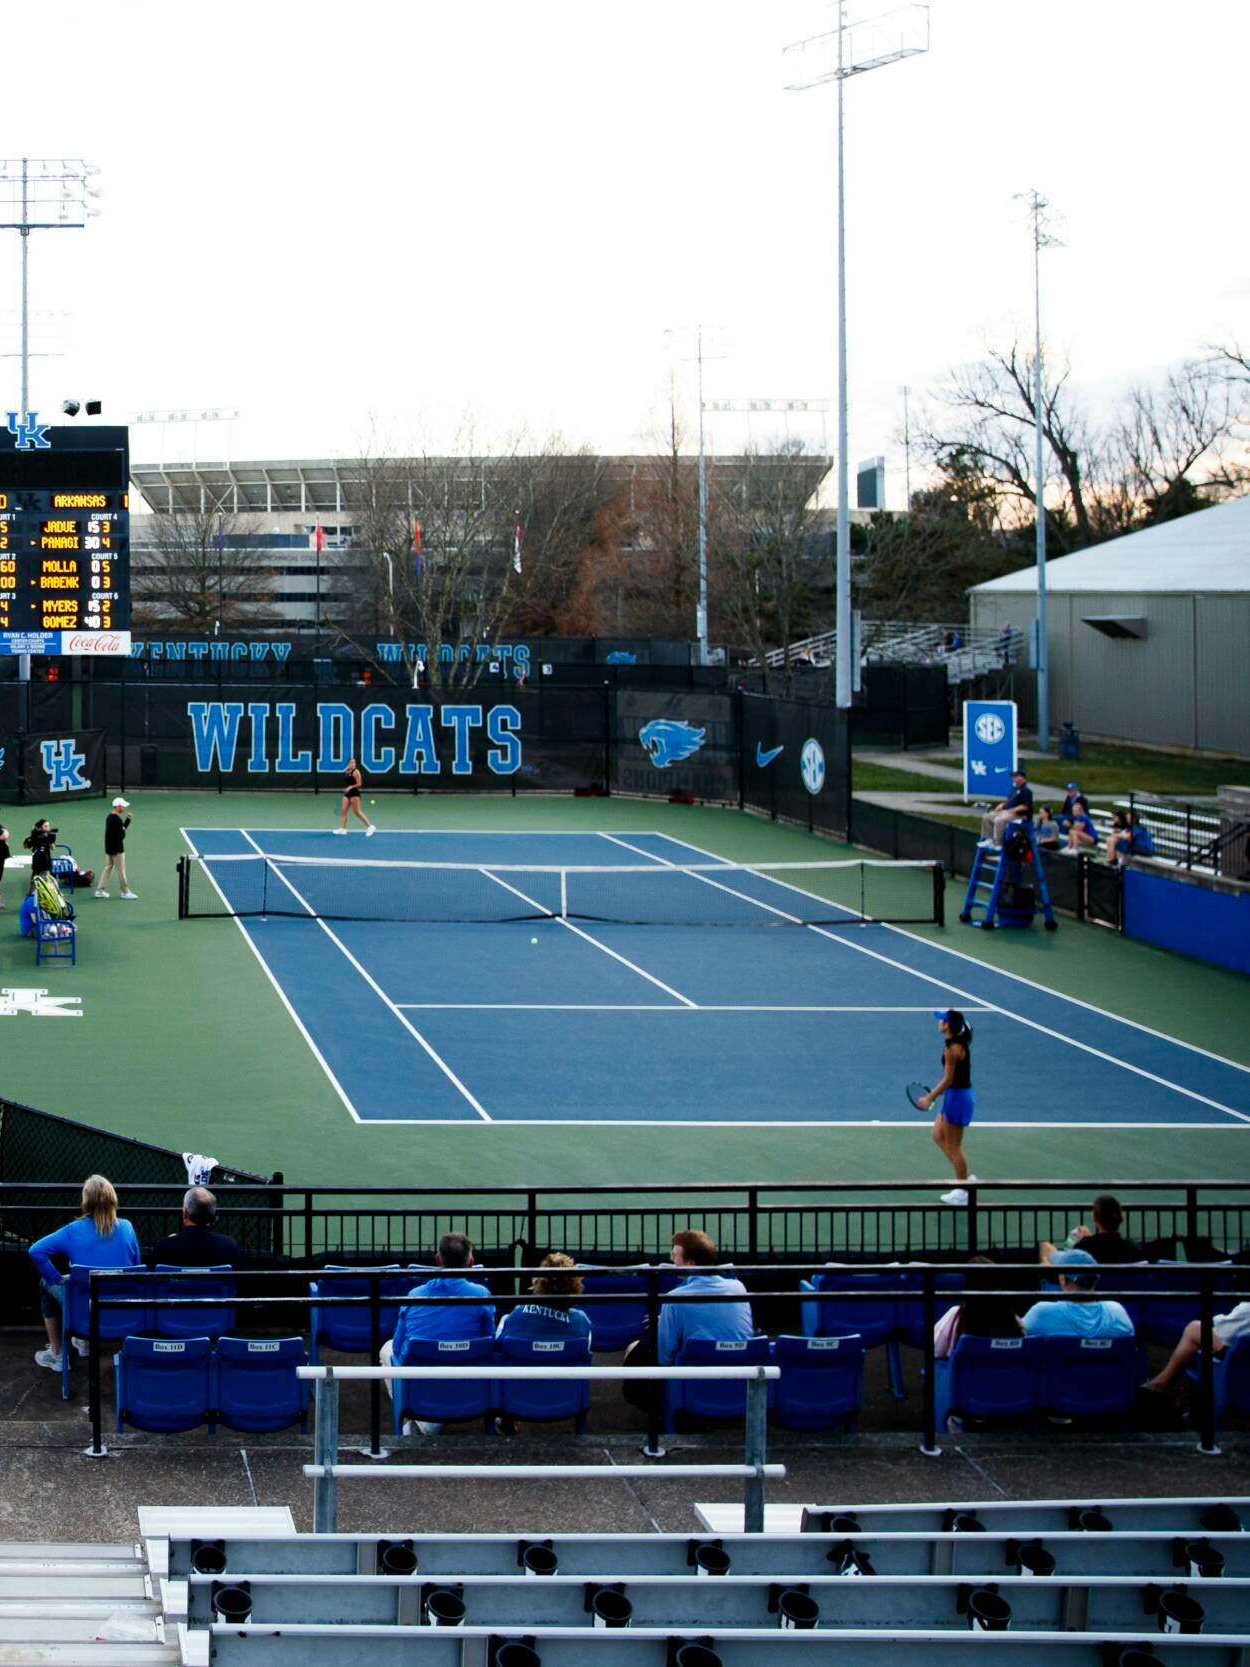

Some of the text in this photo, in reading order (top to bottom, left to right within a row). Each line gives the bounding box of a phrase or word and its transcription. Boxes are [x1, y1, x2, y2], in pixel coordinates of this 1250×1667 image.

[6, 411, 51, 448] UK
[54, 495, 106, 508] ARKANSAS
[44, 521, 110, 533] JADUE 15 3
[0, 537, 8, 549] 2
[42, 537, 110, 549] PANAGI 30 4
[0, 561, 16, 573] 60
[43, 561, 110, 573] MOLLA 0 5
[40, 576, 110, 588] BABENK 0 3
[0, 600, 8, 612] 4
[43, 600, 78, 612] MYERS
[102, 600, 110, 612] 2
[0, 616, 8, 628] 4
[43, 616, 77, 628] GOMEZ
[103, 616, 110, 628] 3
[188, 703, 522, 774] WILDCATS
[40, 739, 86, 792] UK
